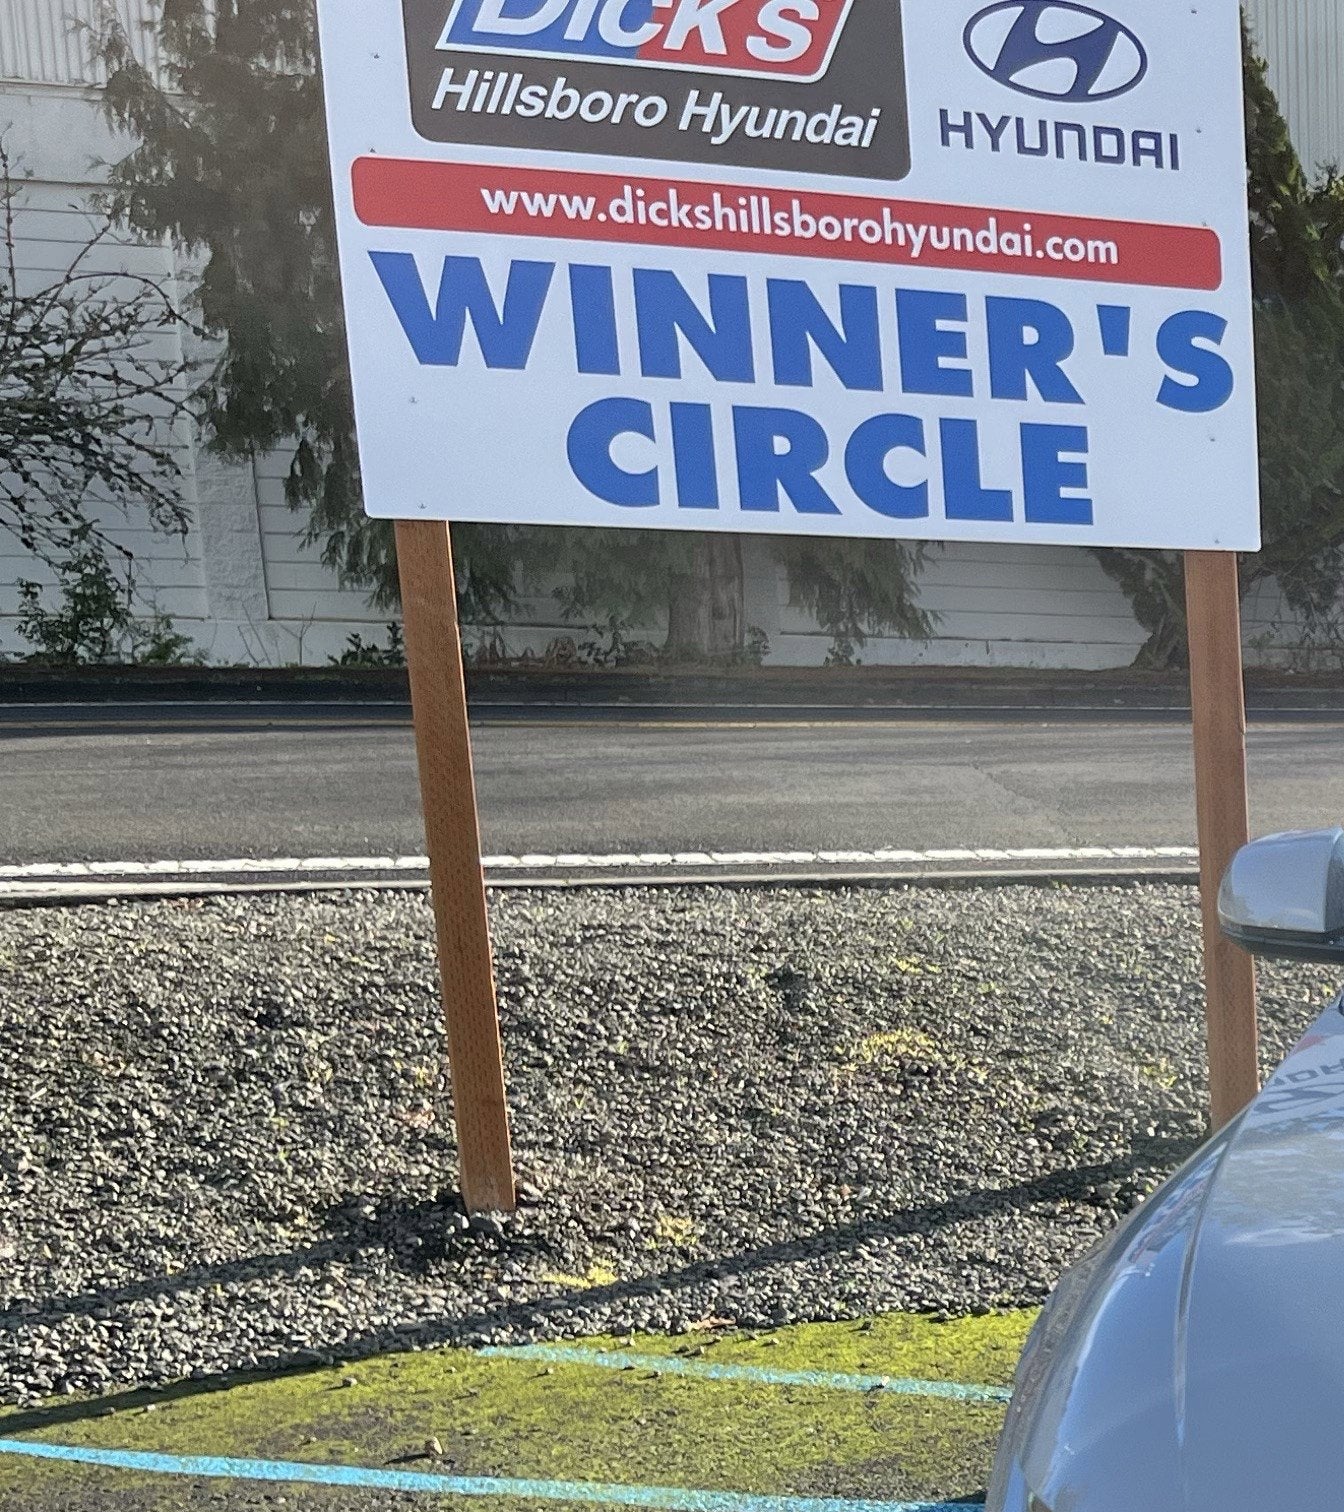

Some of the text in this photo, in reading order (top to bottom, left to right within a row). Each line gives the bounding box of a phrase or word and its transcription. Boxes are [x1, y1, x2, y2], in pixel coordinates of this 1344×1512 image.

[431, 66, 880, 148] Hillsboro Hyundai
[939, 107, 1180, 171] HYUNDAI
[480, 184, 1119, 266] www.dickshillsborohyundai.com
[368, 249, 1234, 413] WINNER'S
[567, 396, 1094, 525] CIRCLE
